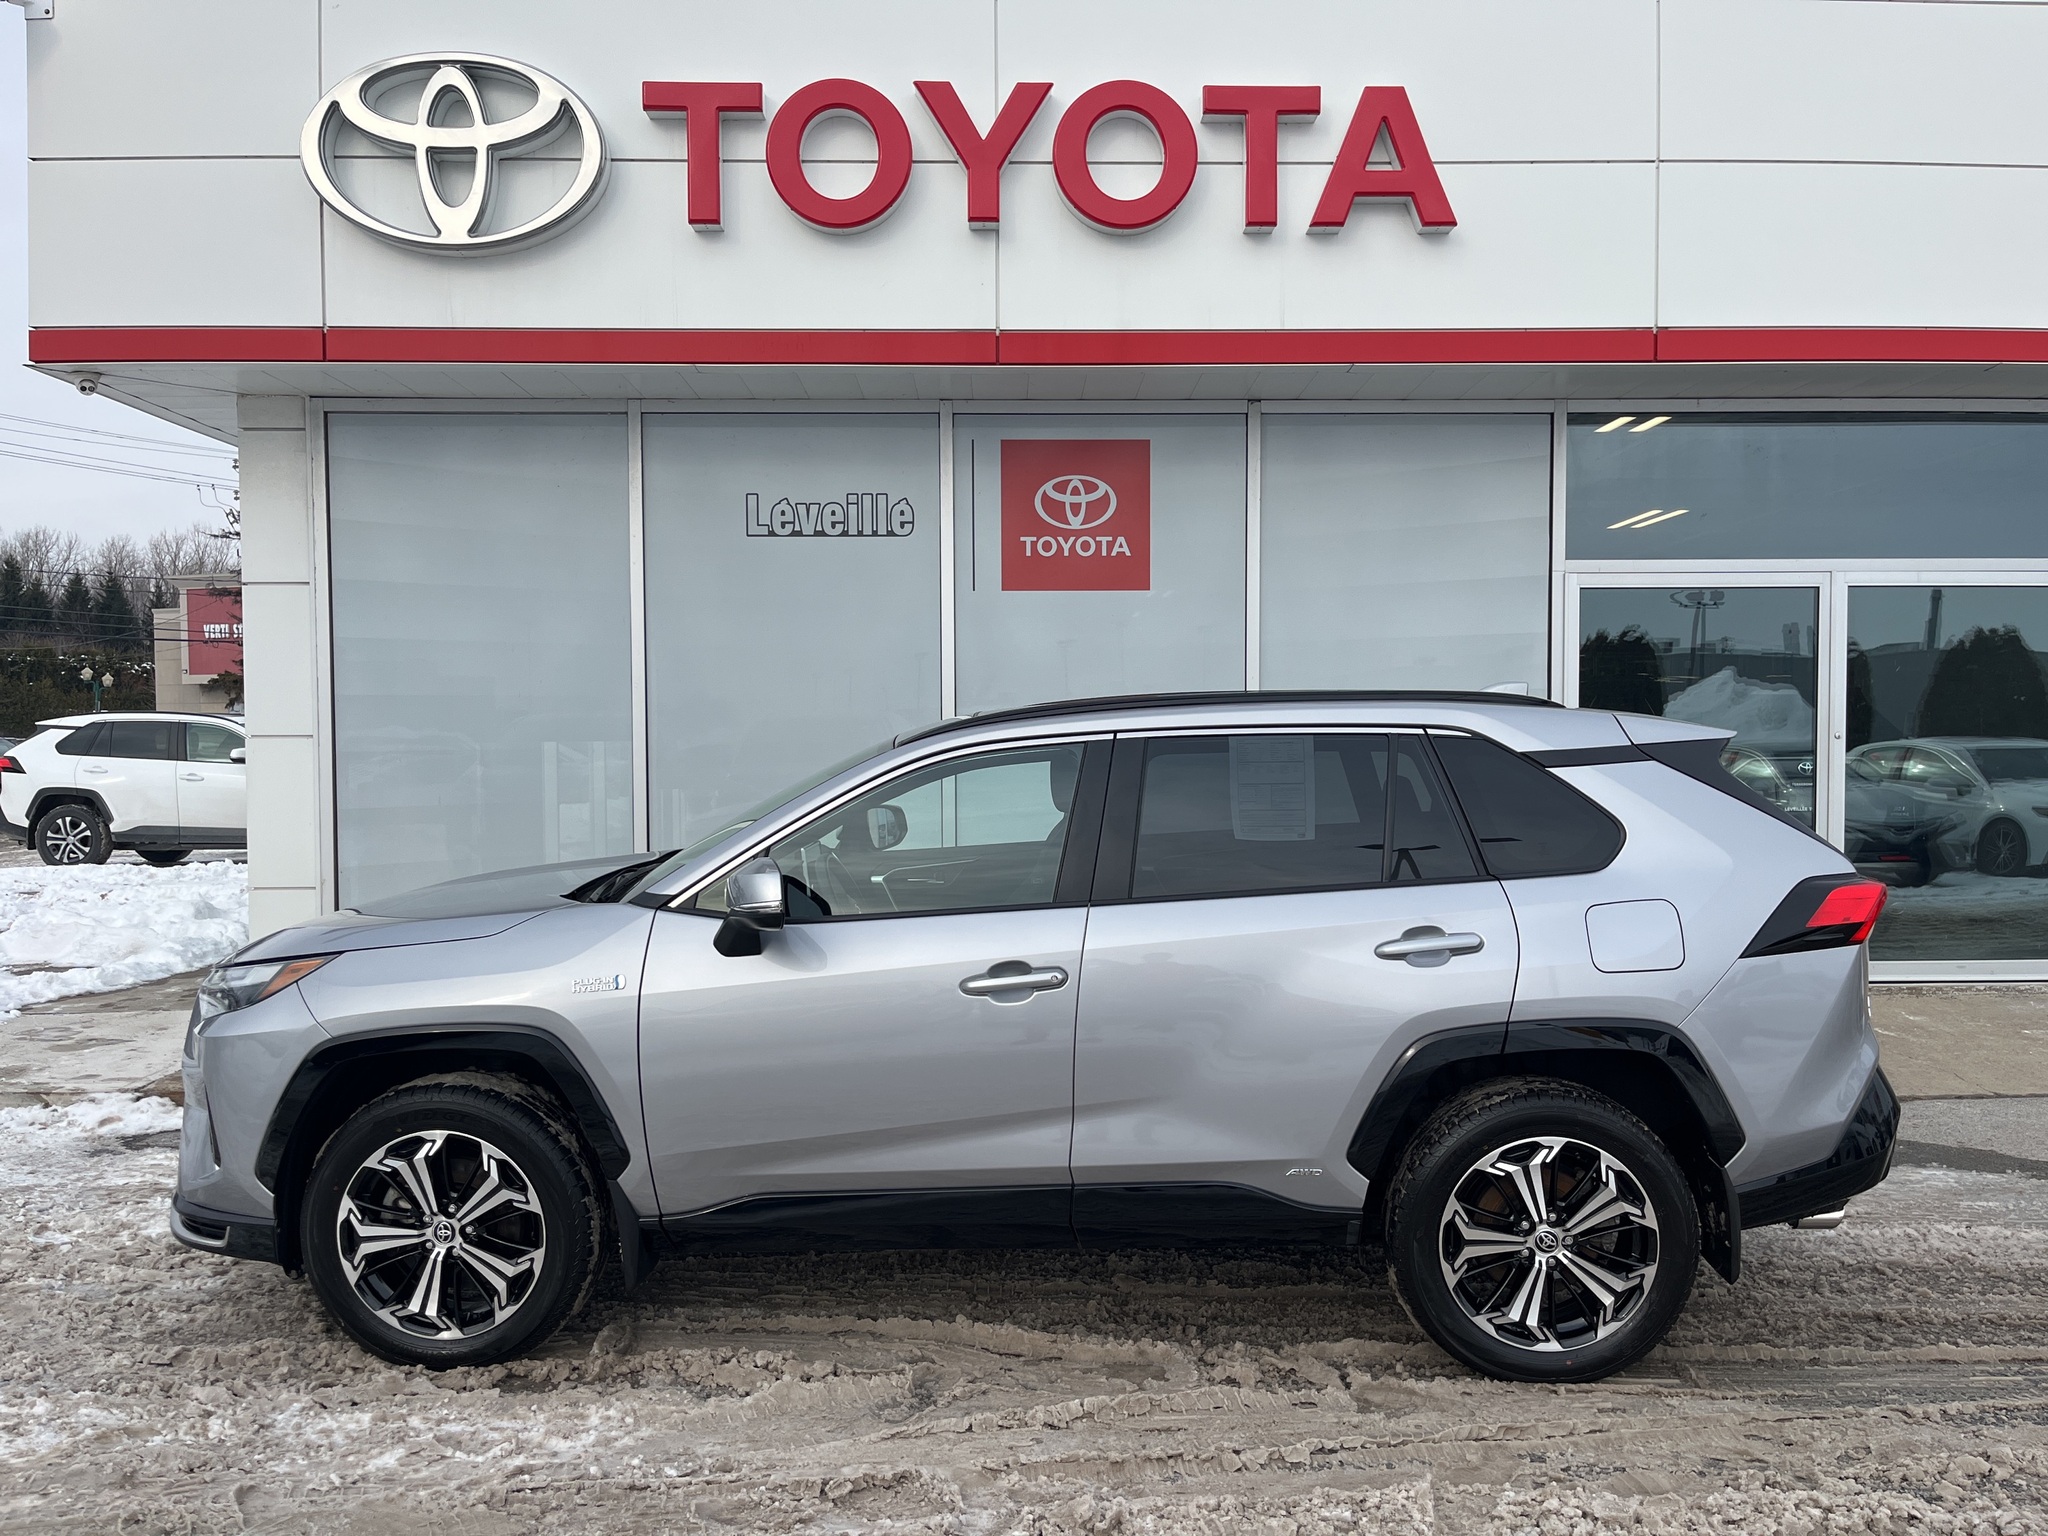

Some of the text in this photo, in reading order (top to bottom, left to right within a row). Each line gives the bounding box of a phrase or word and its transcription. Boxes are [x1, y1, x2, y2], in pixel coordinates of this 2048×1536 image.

[641, 78, 1457, 235] TOYOTA
[745, 492, 915, 538] Léveillé
[1019, 535, 1132, 558] TOYOTA
[1285, 1168, 1323, 1176] AWD
